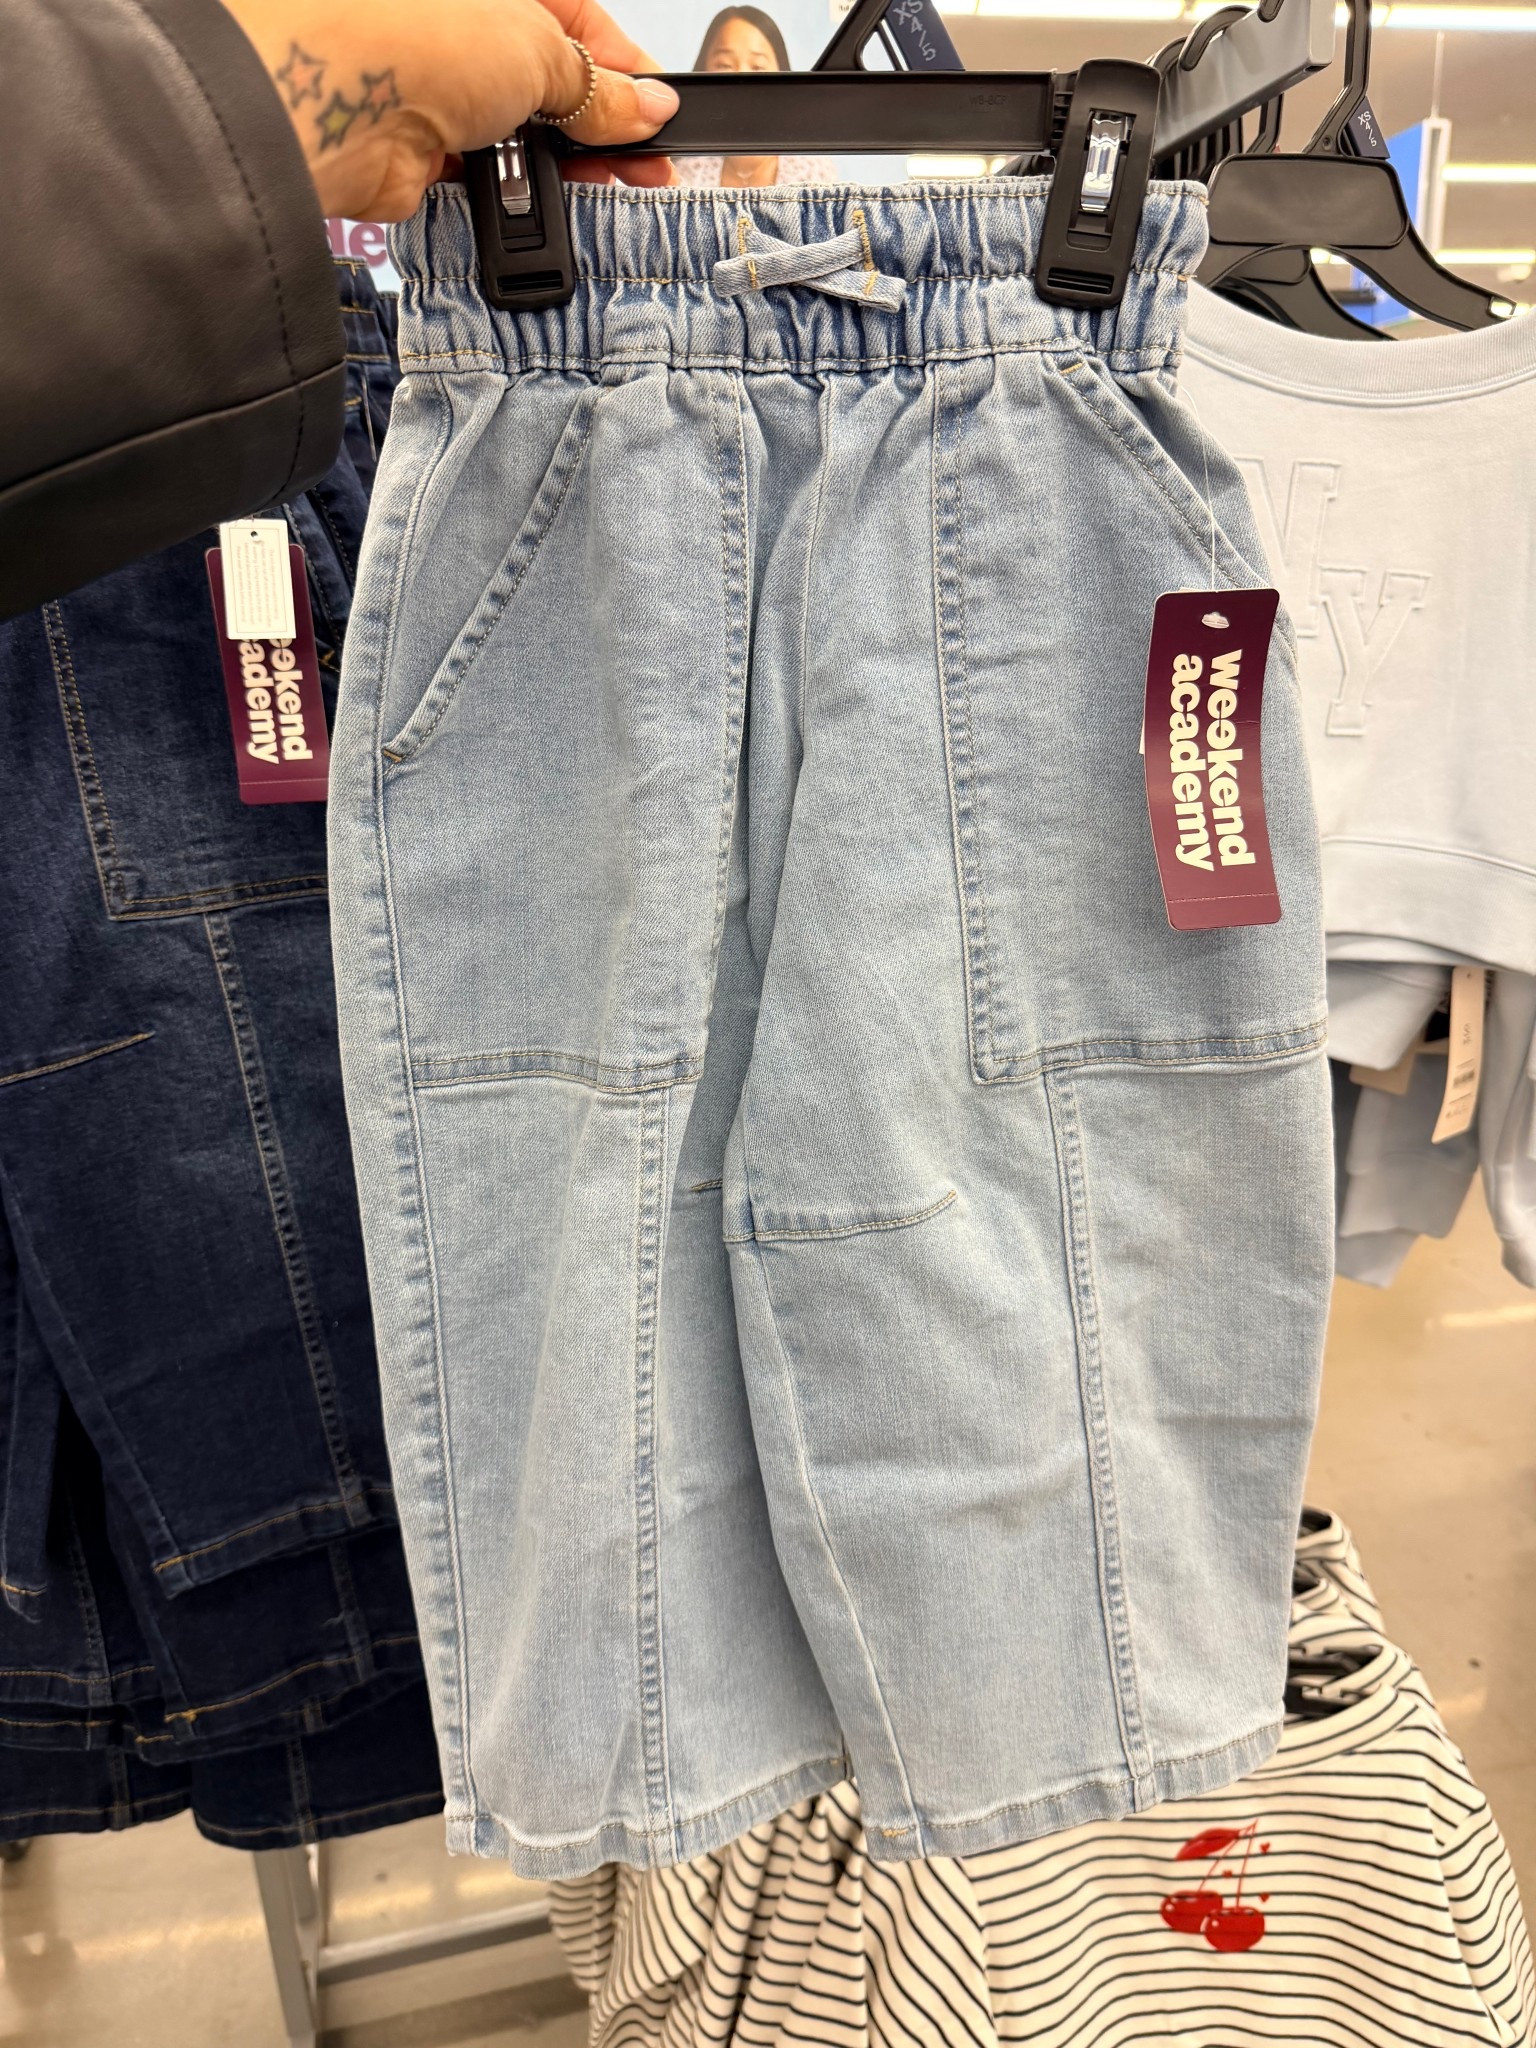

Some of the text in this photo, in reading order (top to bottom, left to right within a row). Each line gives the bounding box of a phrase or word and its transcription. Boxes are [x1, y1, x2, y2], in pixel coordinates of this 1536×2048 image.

[892, 0, 924, 25] XS
[1357, 111, 1372, 126] XS
[238, 638, 280, 765] ademy
[269, 638, 314, 761] ekend
[1205, 648, 1257, 867] weekend
[1169, 653, 1215, 872] academy
